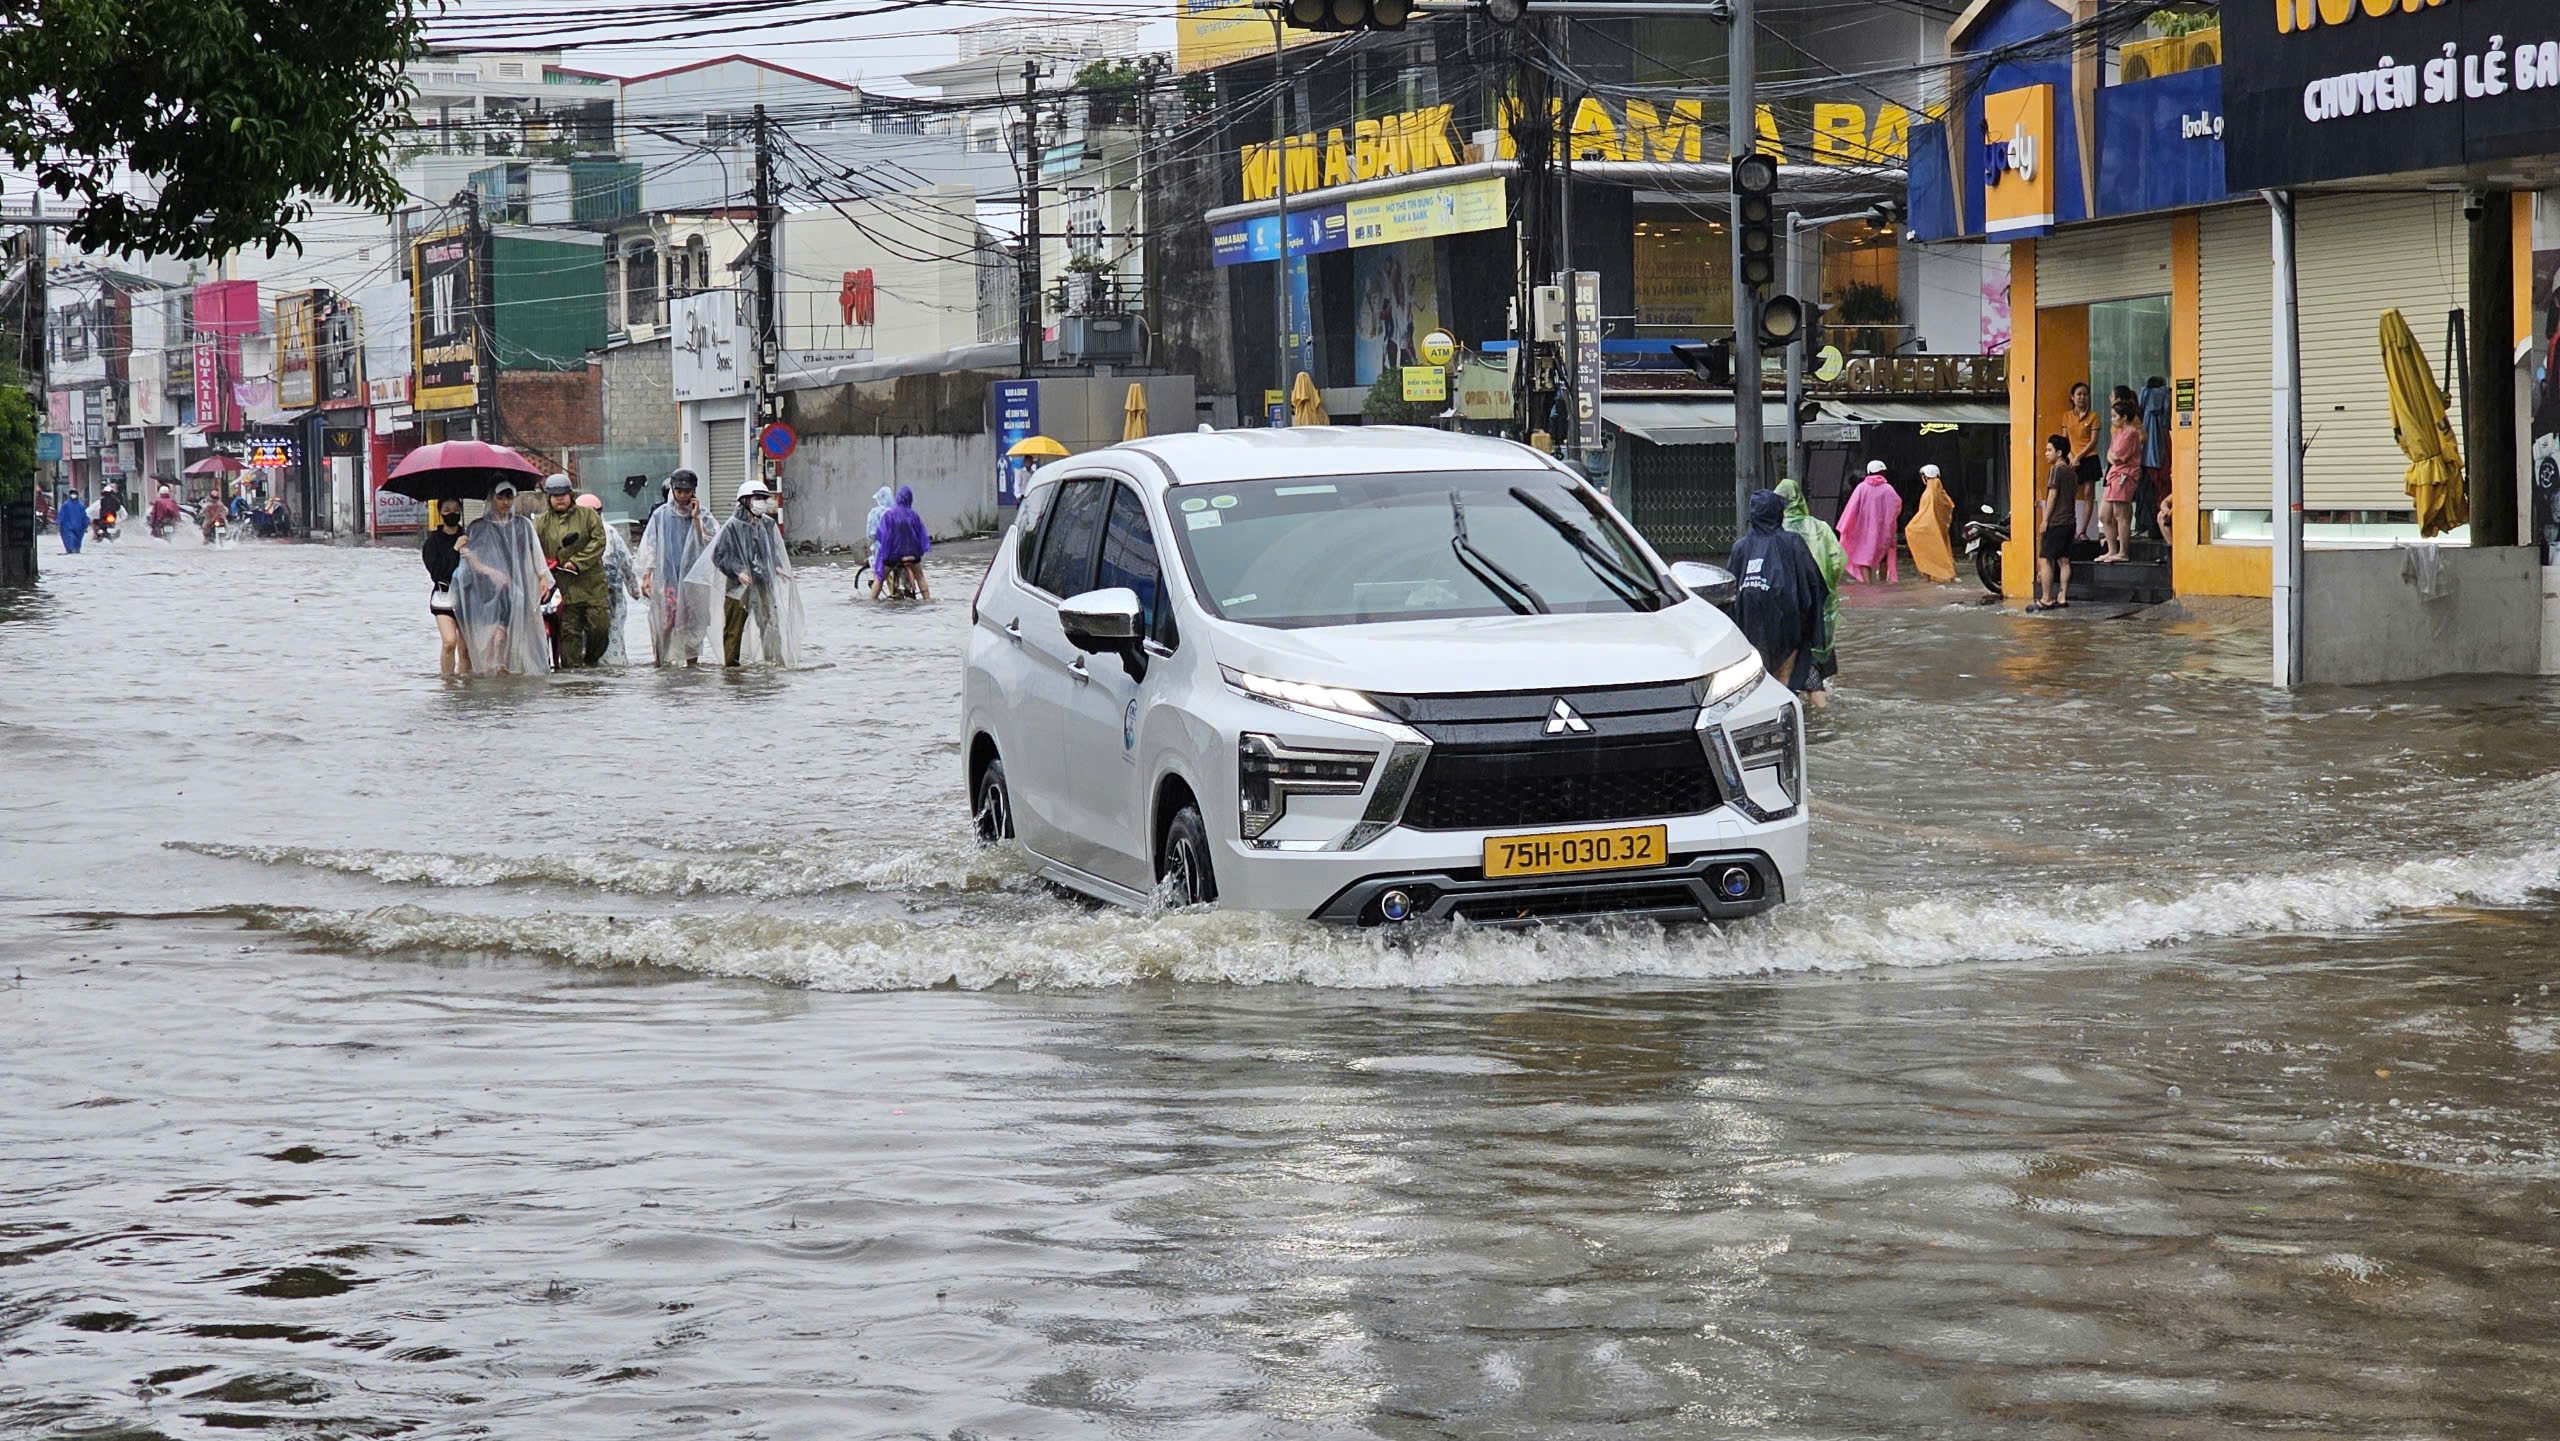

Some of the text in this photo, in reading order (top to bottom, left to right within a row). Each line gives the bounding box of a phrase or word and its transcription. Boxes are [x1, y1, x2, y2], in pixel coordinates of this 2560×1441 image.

[2303, 34, 2560, 123] CHUYÊN SỈ LẺ BA
[2182, 110, 2225, 141] look g
[1241, 103, 1456, 202] NAM A BANK
[1984, 122, 2037, 187] yody
[1431, 348, 1450, 358] ATM
[1846, 358, 1961, 391] GREEN
[1969, 358, 2007, 391] TE
[1500, 834, 1652, 869] 75H-030.32
